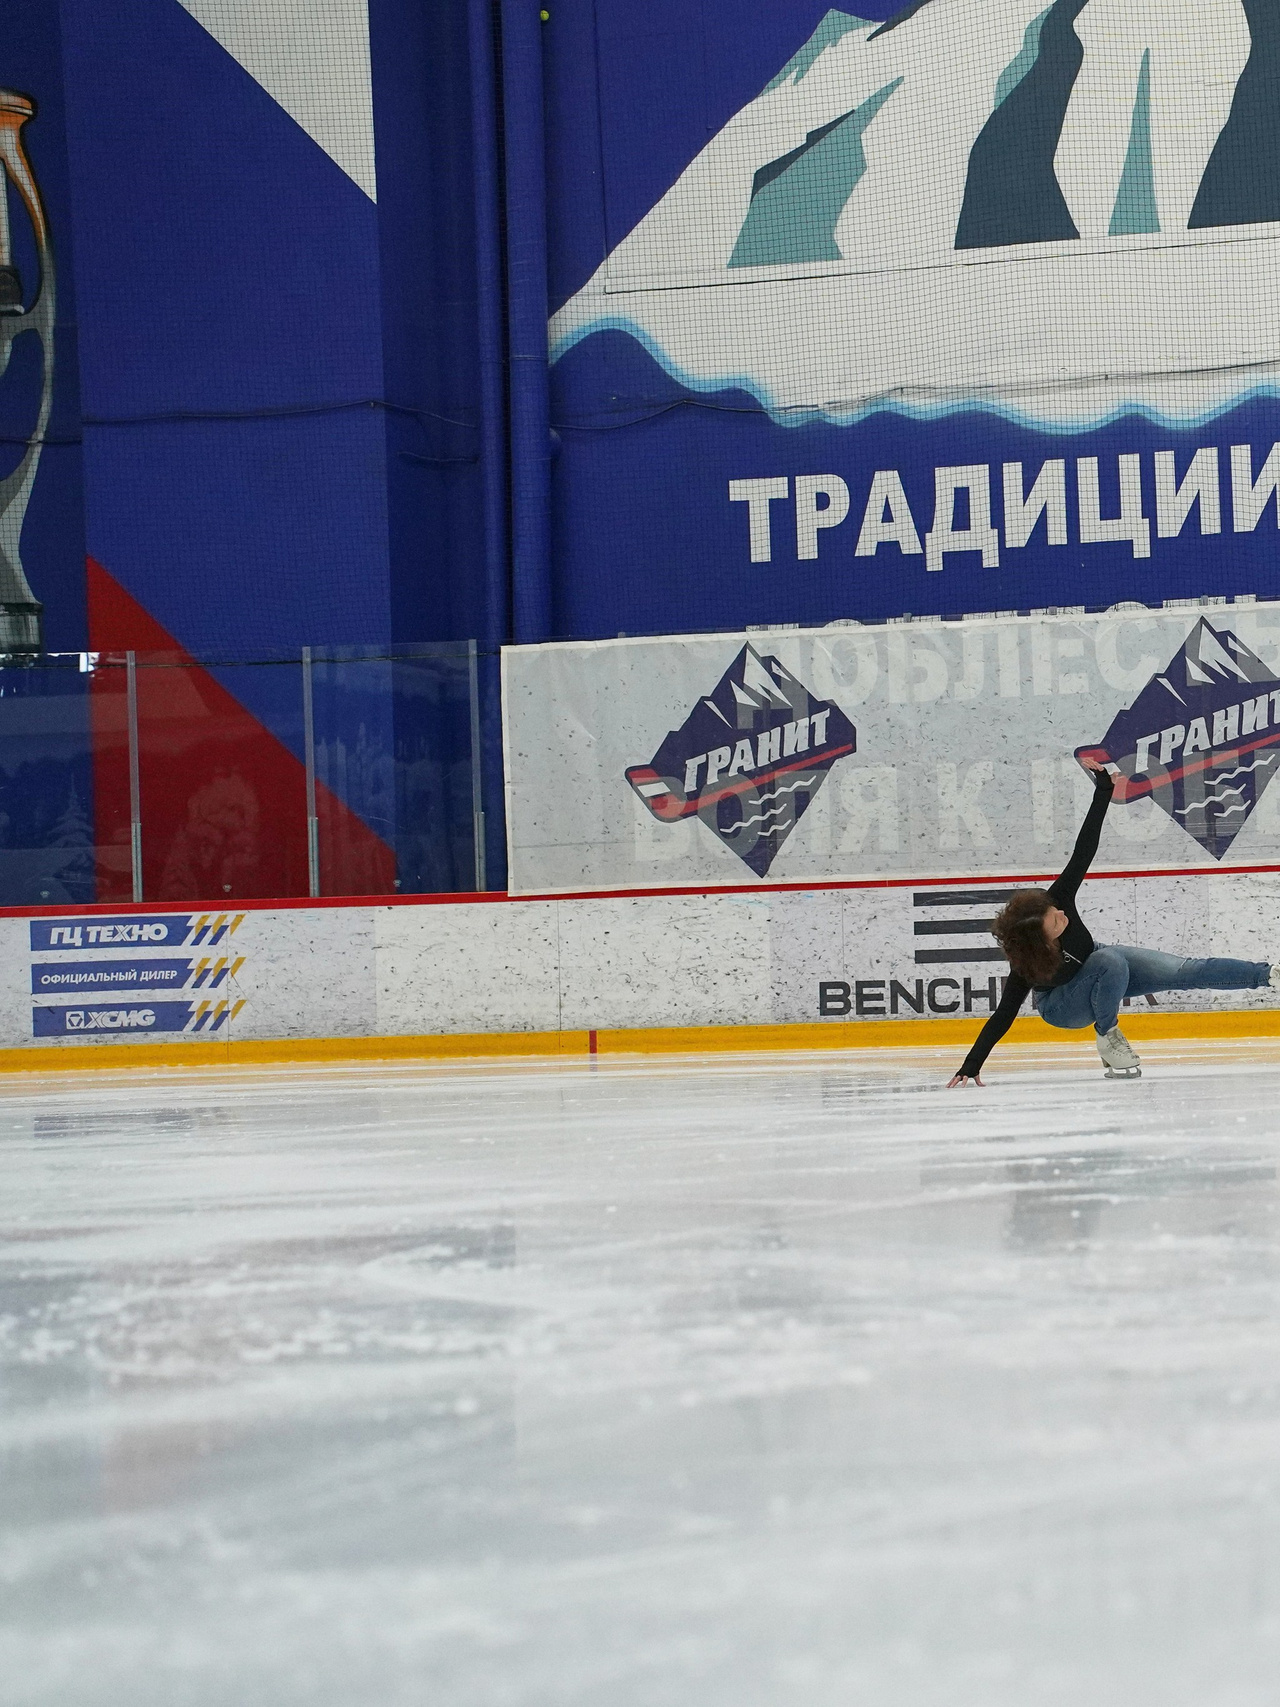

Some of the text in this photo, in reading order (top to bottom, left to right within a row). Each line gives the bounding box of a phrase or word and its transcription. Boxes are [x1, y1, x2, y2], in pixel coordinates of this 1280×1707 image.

[683, 708, 831, 793] ГРАНИТ
[50, 923, 168, 946] ГЦ ТЕХНО
[41, 968, 178, 985] ОФИЦИАЛЬНЫЙ ДИЛЕР
[85, 1009, 156, 1029] XCMG
